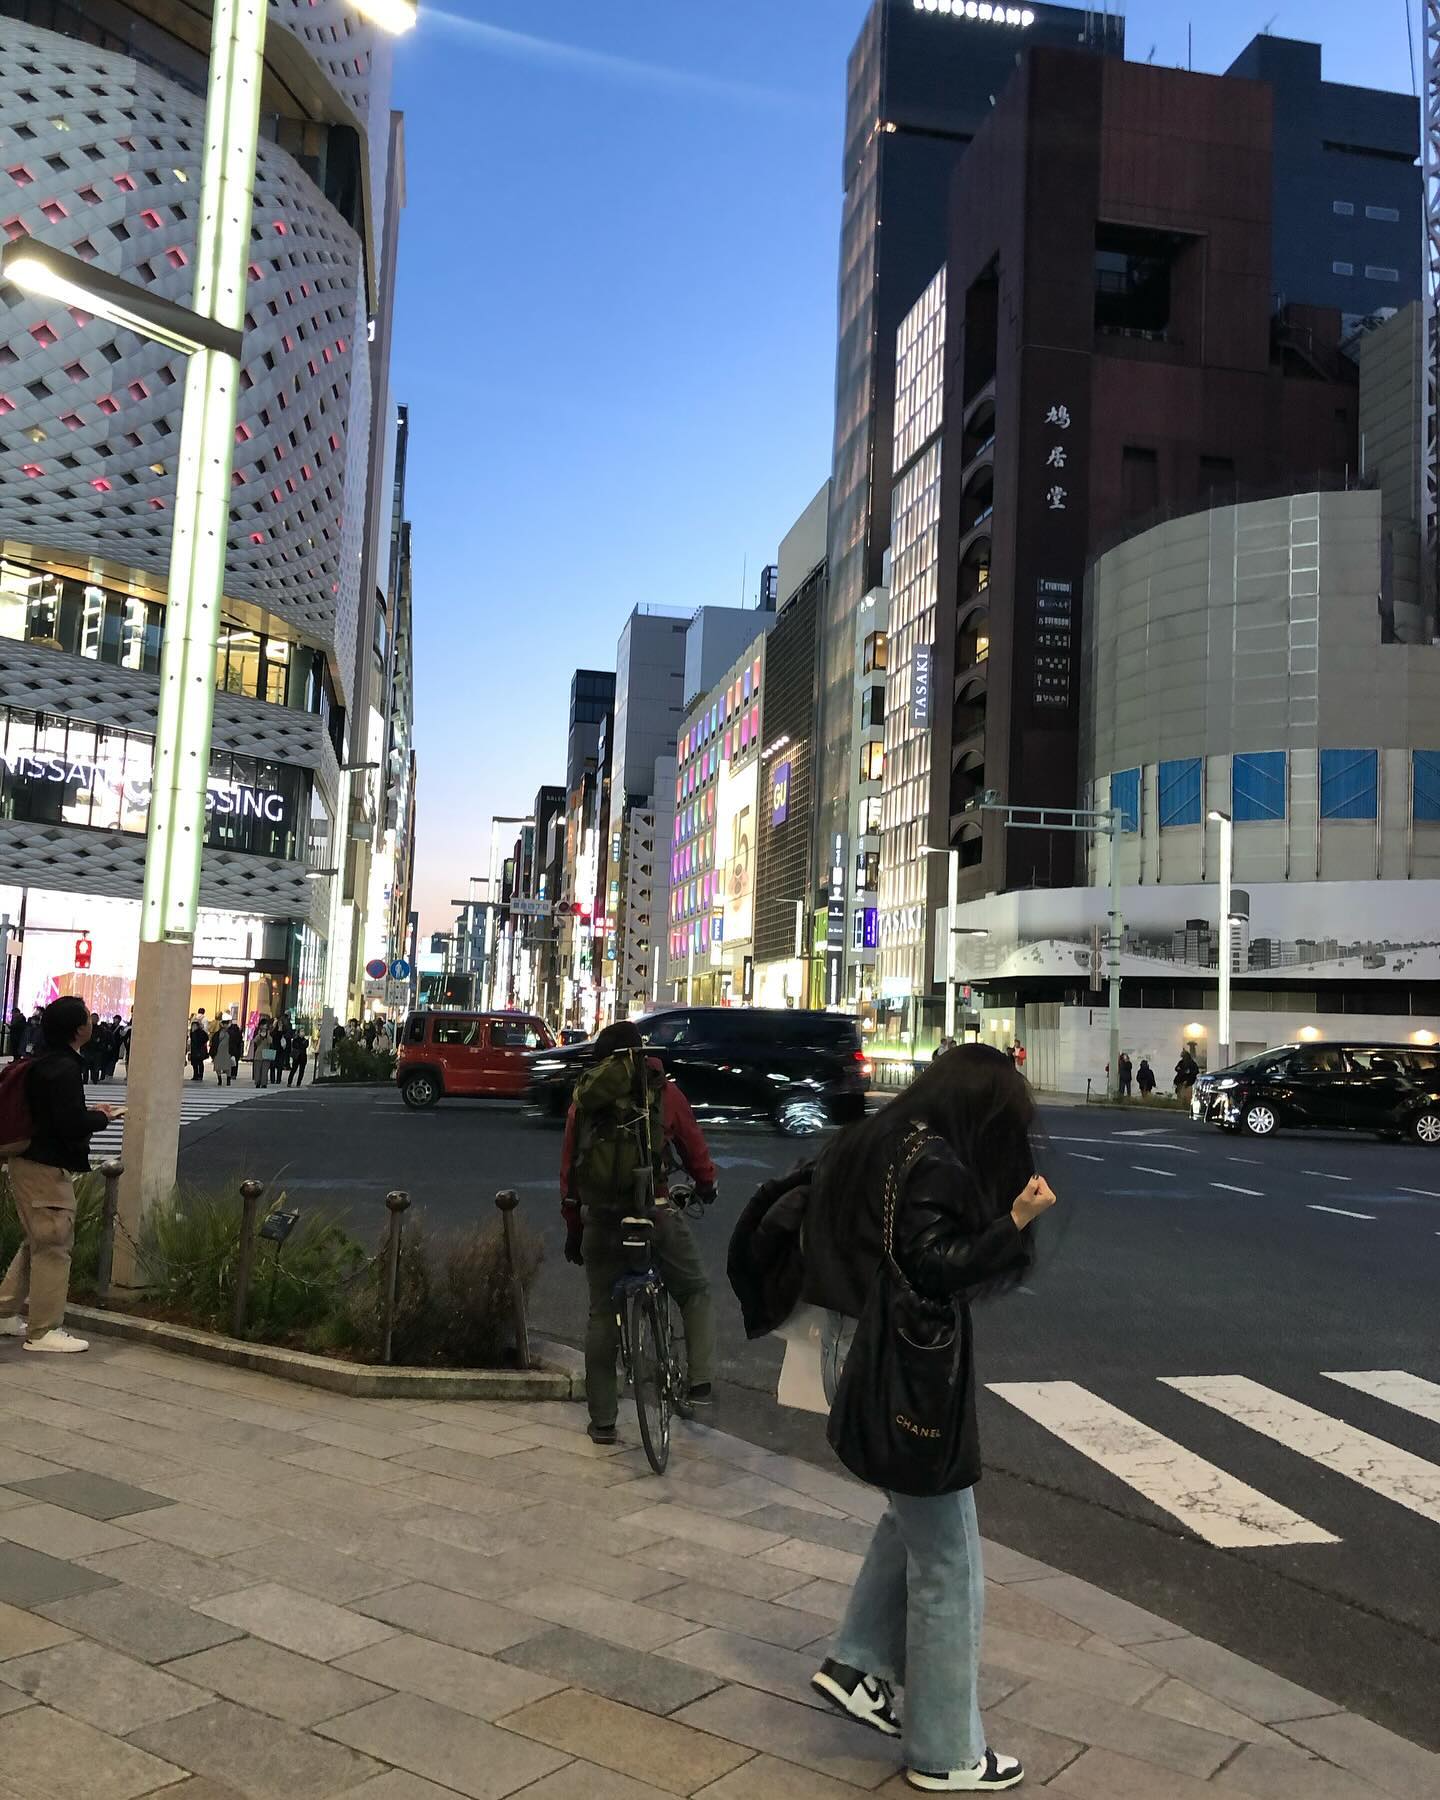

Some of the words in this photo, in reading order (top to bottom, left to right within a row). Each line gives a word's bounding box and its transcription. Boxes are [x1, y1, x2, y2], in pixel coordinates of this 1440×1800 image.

[1044, 404, 1071, 509] 鳩居堂
[914, 653, 928, 720] TASAKI
[0, 754, 109, 792] NISSAN
[773, 780, 787, 811] GU
[877, 905, 922, 939] TASAKI
[896, 1415, 942, 1438] CHANEL
